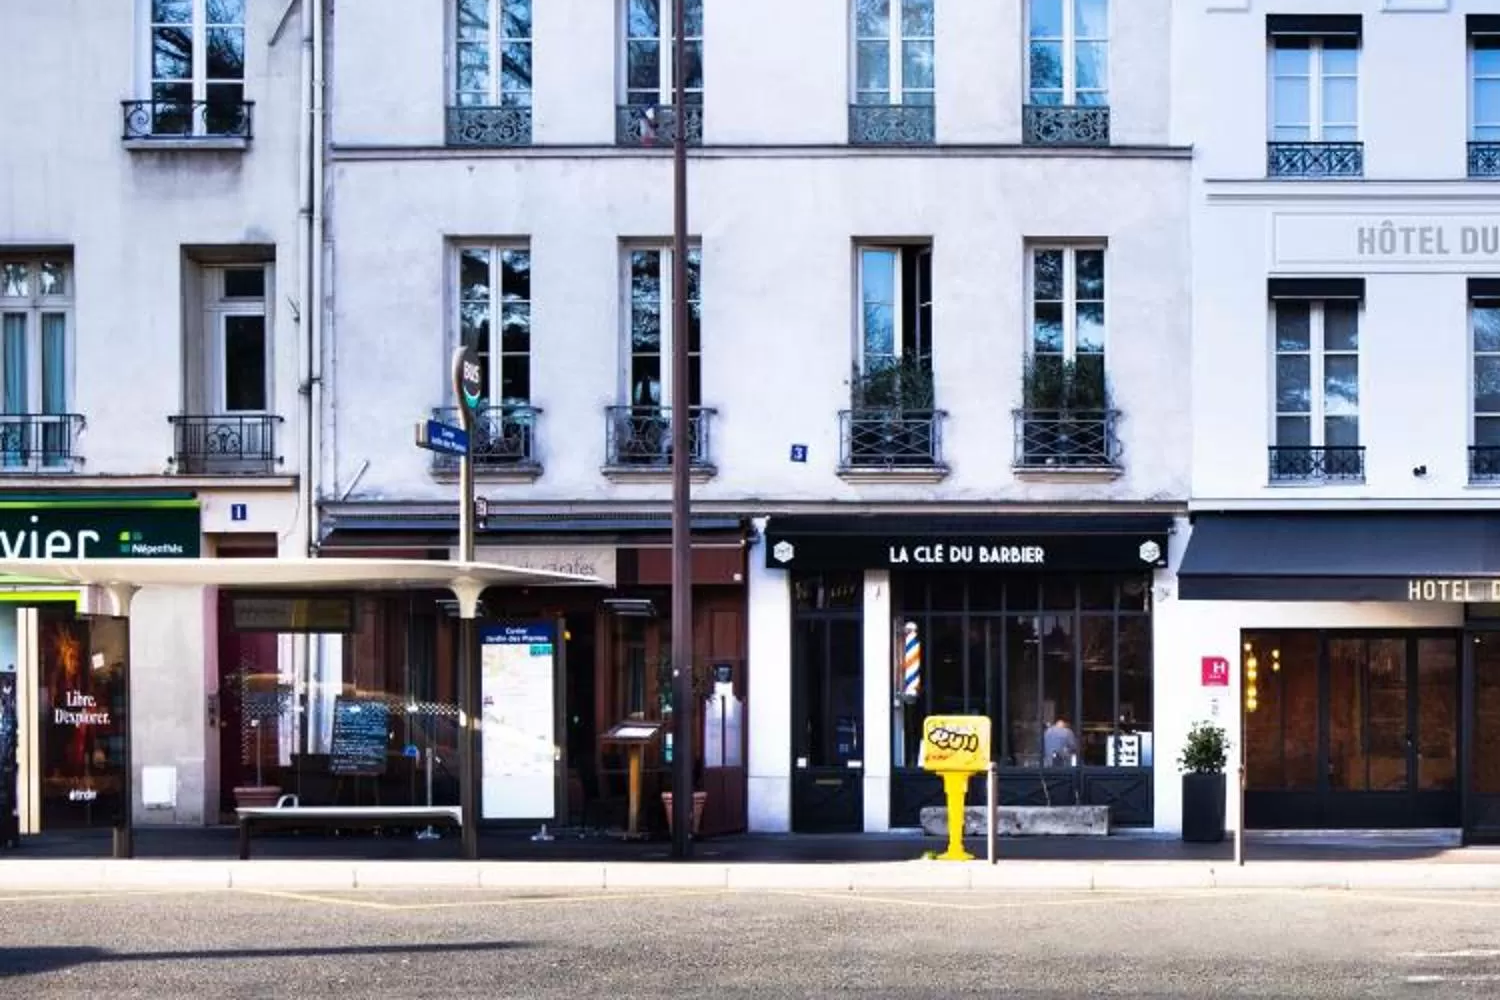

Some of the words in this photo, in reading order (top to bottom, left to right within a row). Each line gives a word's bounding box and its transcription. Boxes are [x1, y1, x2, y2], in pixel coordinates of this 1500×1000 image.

[1357, 219, 1449, 255] HÔTEL
[1460, 225, 1499, 255] DU
[463, 360, 480, 384] BUS
[889, 545, 910, 564] LA
[914, 542, 944, 564] CLÉ
[950, 545, 974, 564] DU
[979, 545, 1045, 564] BARBIER
[1408, 580, 1473, 601] HOTEL
[1213, 660, 1226, 673] H
